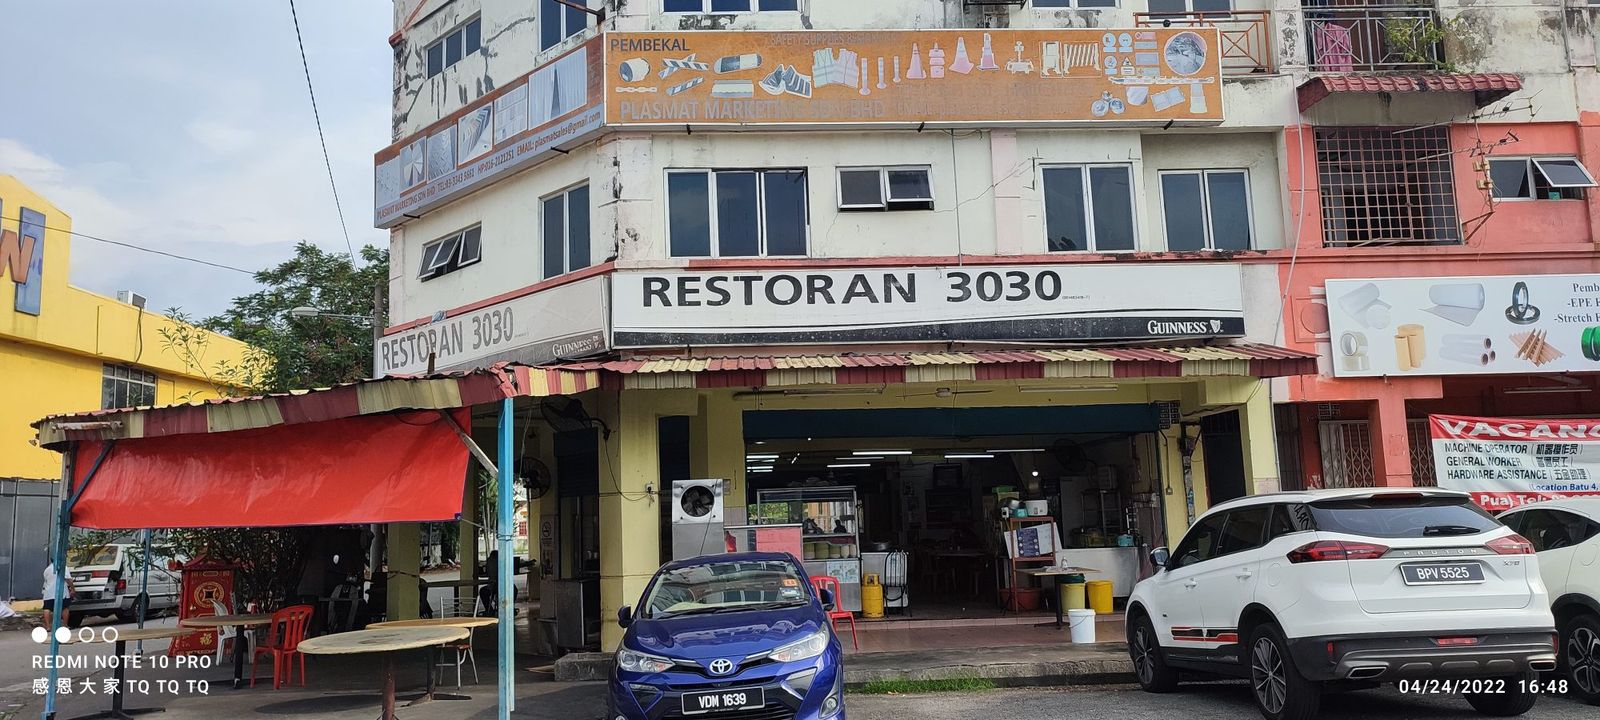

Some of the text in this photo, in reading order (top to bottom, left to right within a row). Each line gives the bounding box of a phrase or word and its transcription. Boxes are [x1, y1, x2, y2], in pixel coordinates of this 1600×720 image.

[610, 38, 691, 52] PEMBEKAL
[620, 100, 699, 120] PLASMAT
[642, 270, 1062, 307] RESTORAN 3030
[1148, 320, 1208, 335] GUINNESS
[382, 306, 514, 371] RESTORAN 3030
[552, 337, 593, 357] GUINNESS
[1444, 442, 1482, 453] MACHINE
[1485, 443, 1528, 454] OPERATOR
[1446, 456, 1485, 466] GENERAL
[1487, 456, 1521, 467] WORKER
[1447, 469, 1494, 480] HARDWARE
[1497, 469, 1548, 480] ASSISTANCE
[1569, 483, 1589, 491] Batu
[1416, 567, 1470, 580] BPV 5525
[698, 692, 747, 708] VDM 1639
